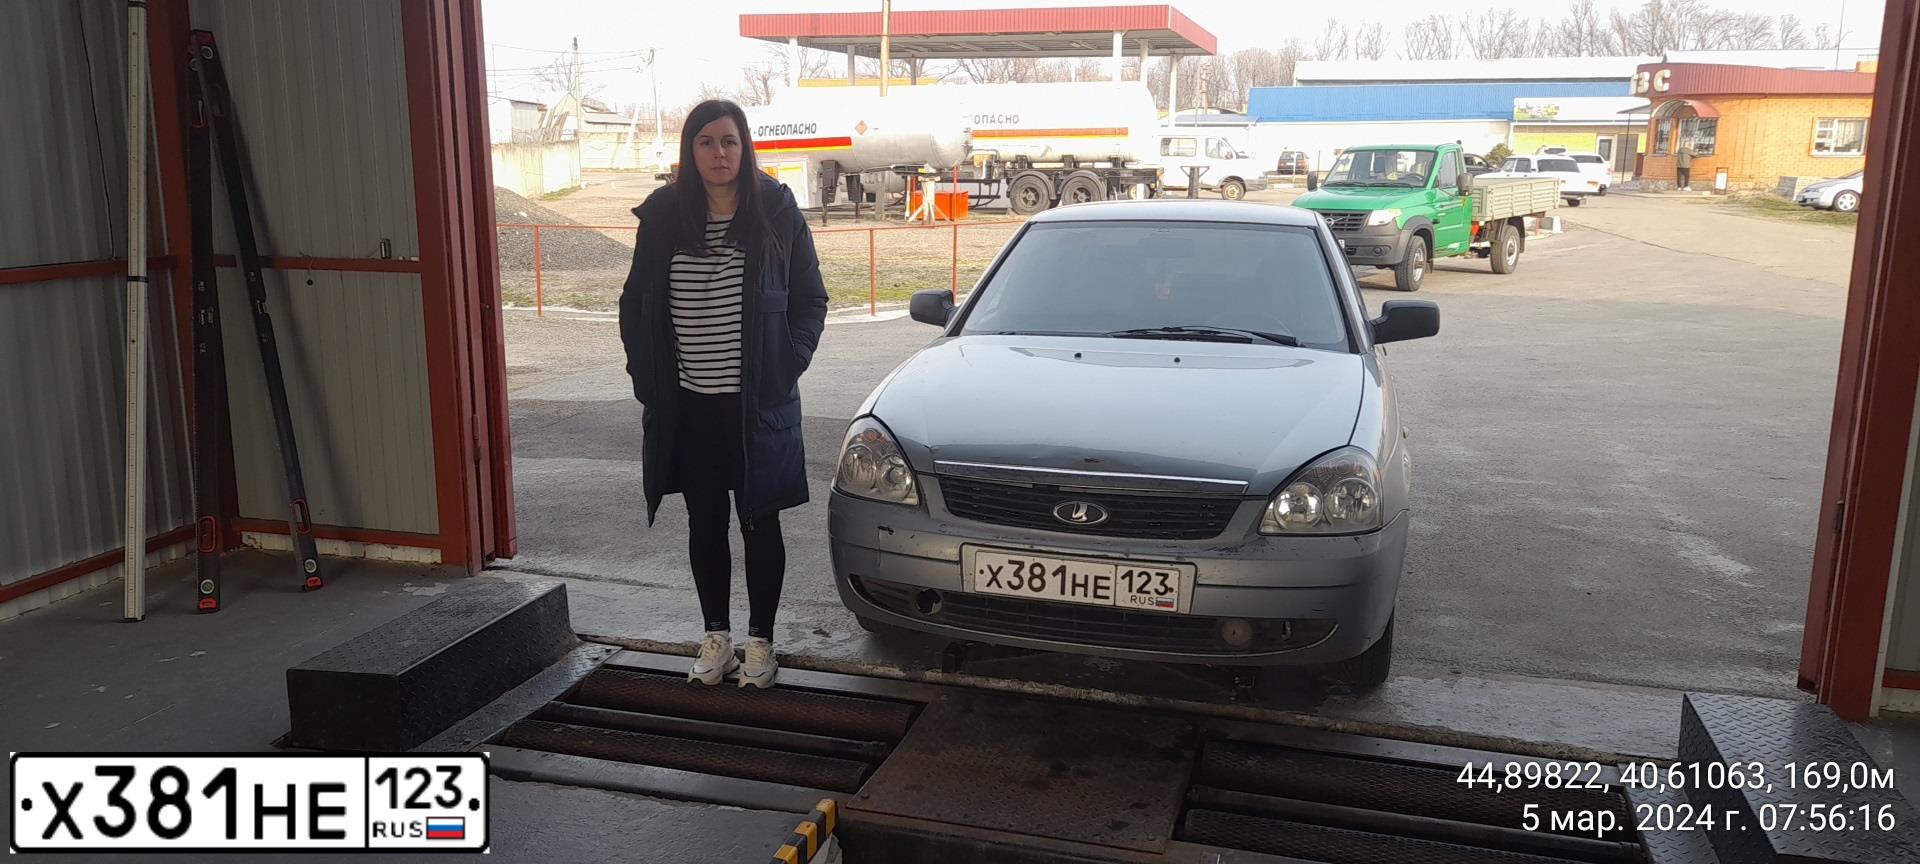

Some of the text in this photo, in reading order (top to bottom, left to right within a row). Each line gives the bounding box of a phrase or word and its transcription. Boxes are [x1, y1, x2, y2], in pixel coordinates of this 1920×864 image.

[970, 114, 1020, 125] ОПАСНО
[758, 122, 817, 137] ОГНЕОПАСНО
[1121, 569, 1170, 596] 123
[1130, 595, 1155, 606] RUS
